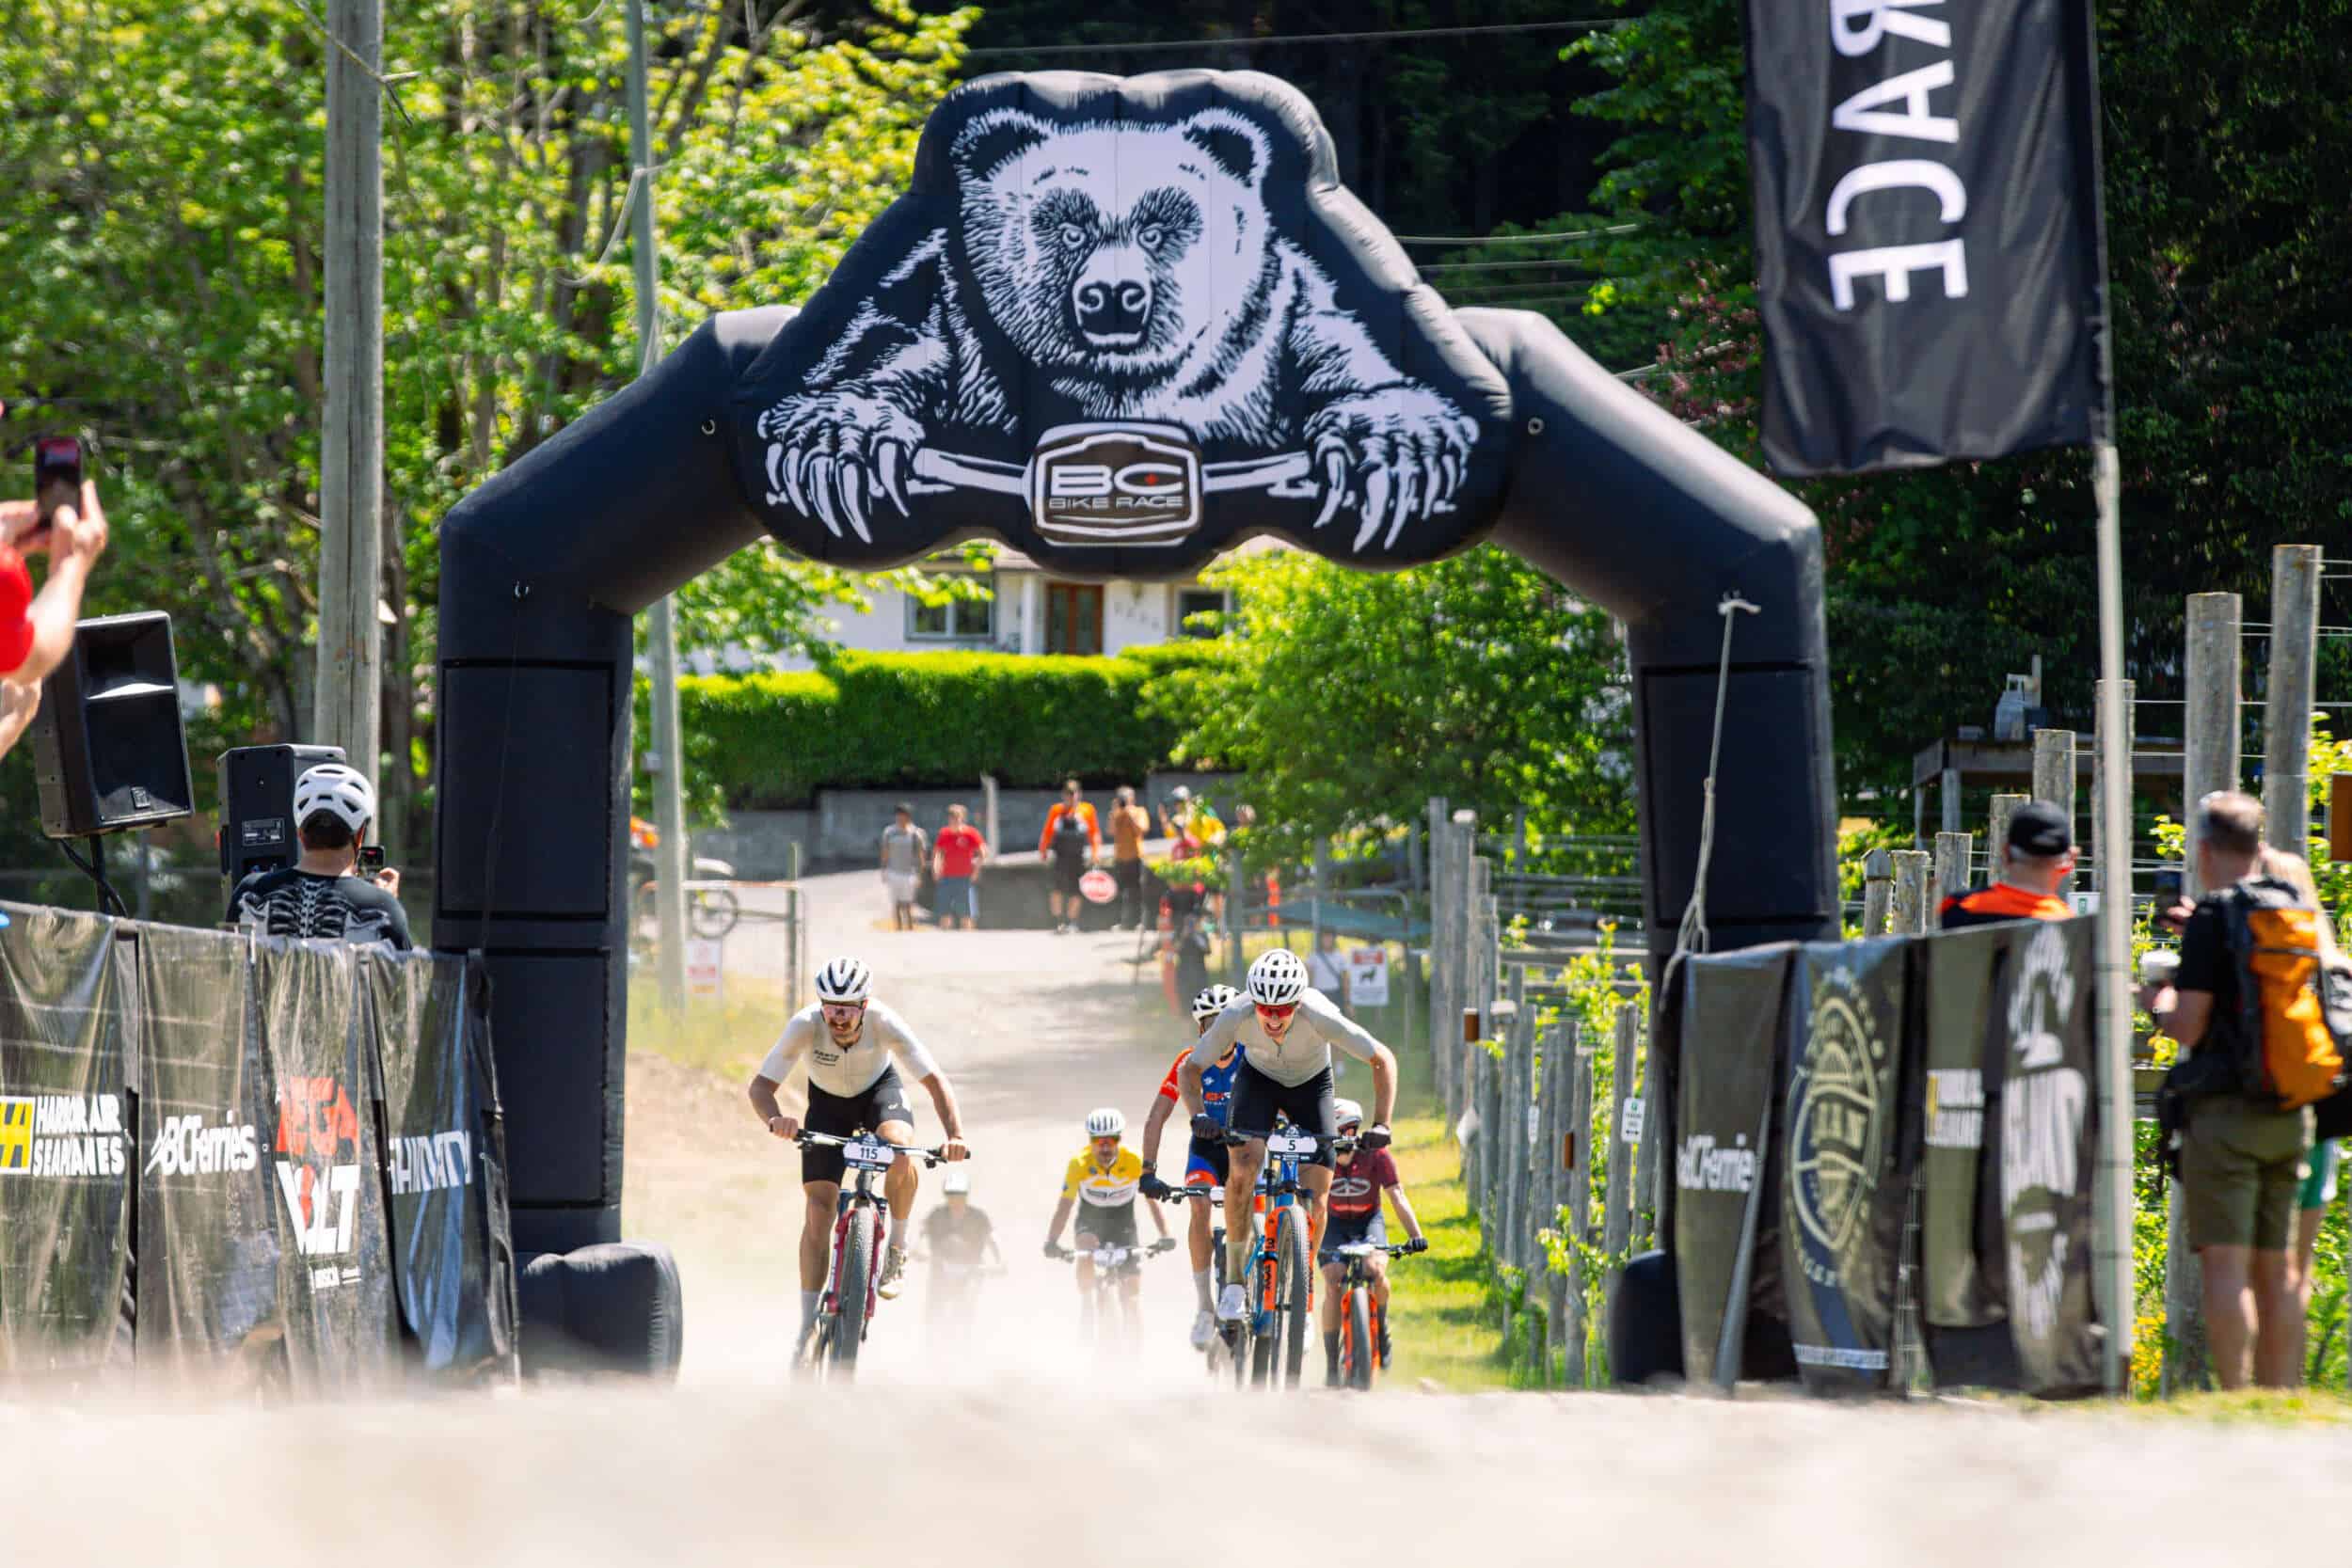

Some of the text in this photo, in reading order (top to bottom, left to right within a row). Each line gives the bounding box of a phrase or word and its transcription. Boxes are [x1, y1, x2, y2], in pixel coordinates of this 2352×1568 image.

[1049, 463, 1184, 496] BC
[1049, 496, 1184, 509] BIKE RACE
[1288, 1139, 1296, 1151] 5
[860, 1148, 878, 1160] 115
